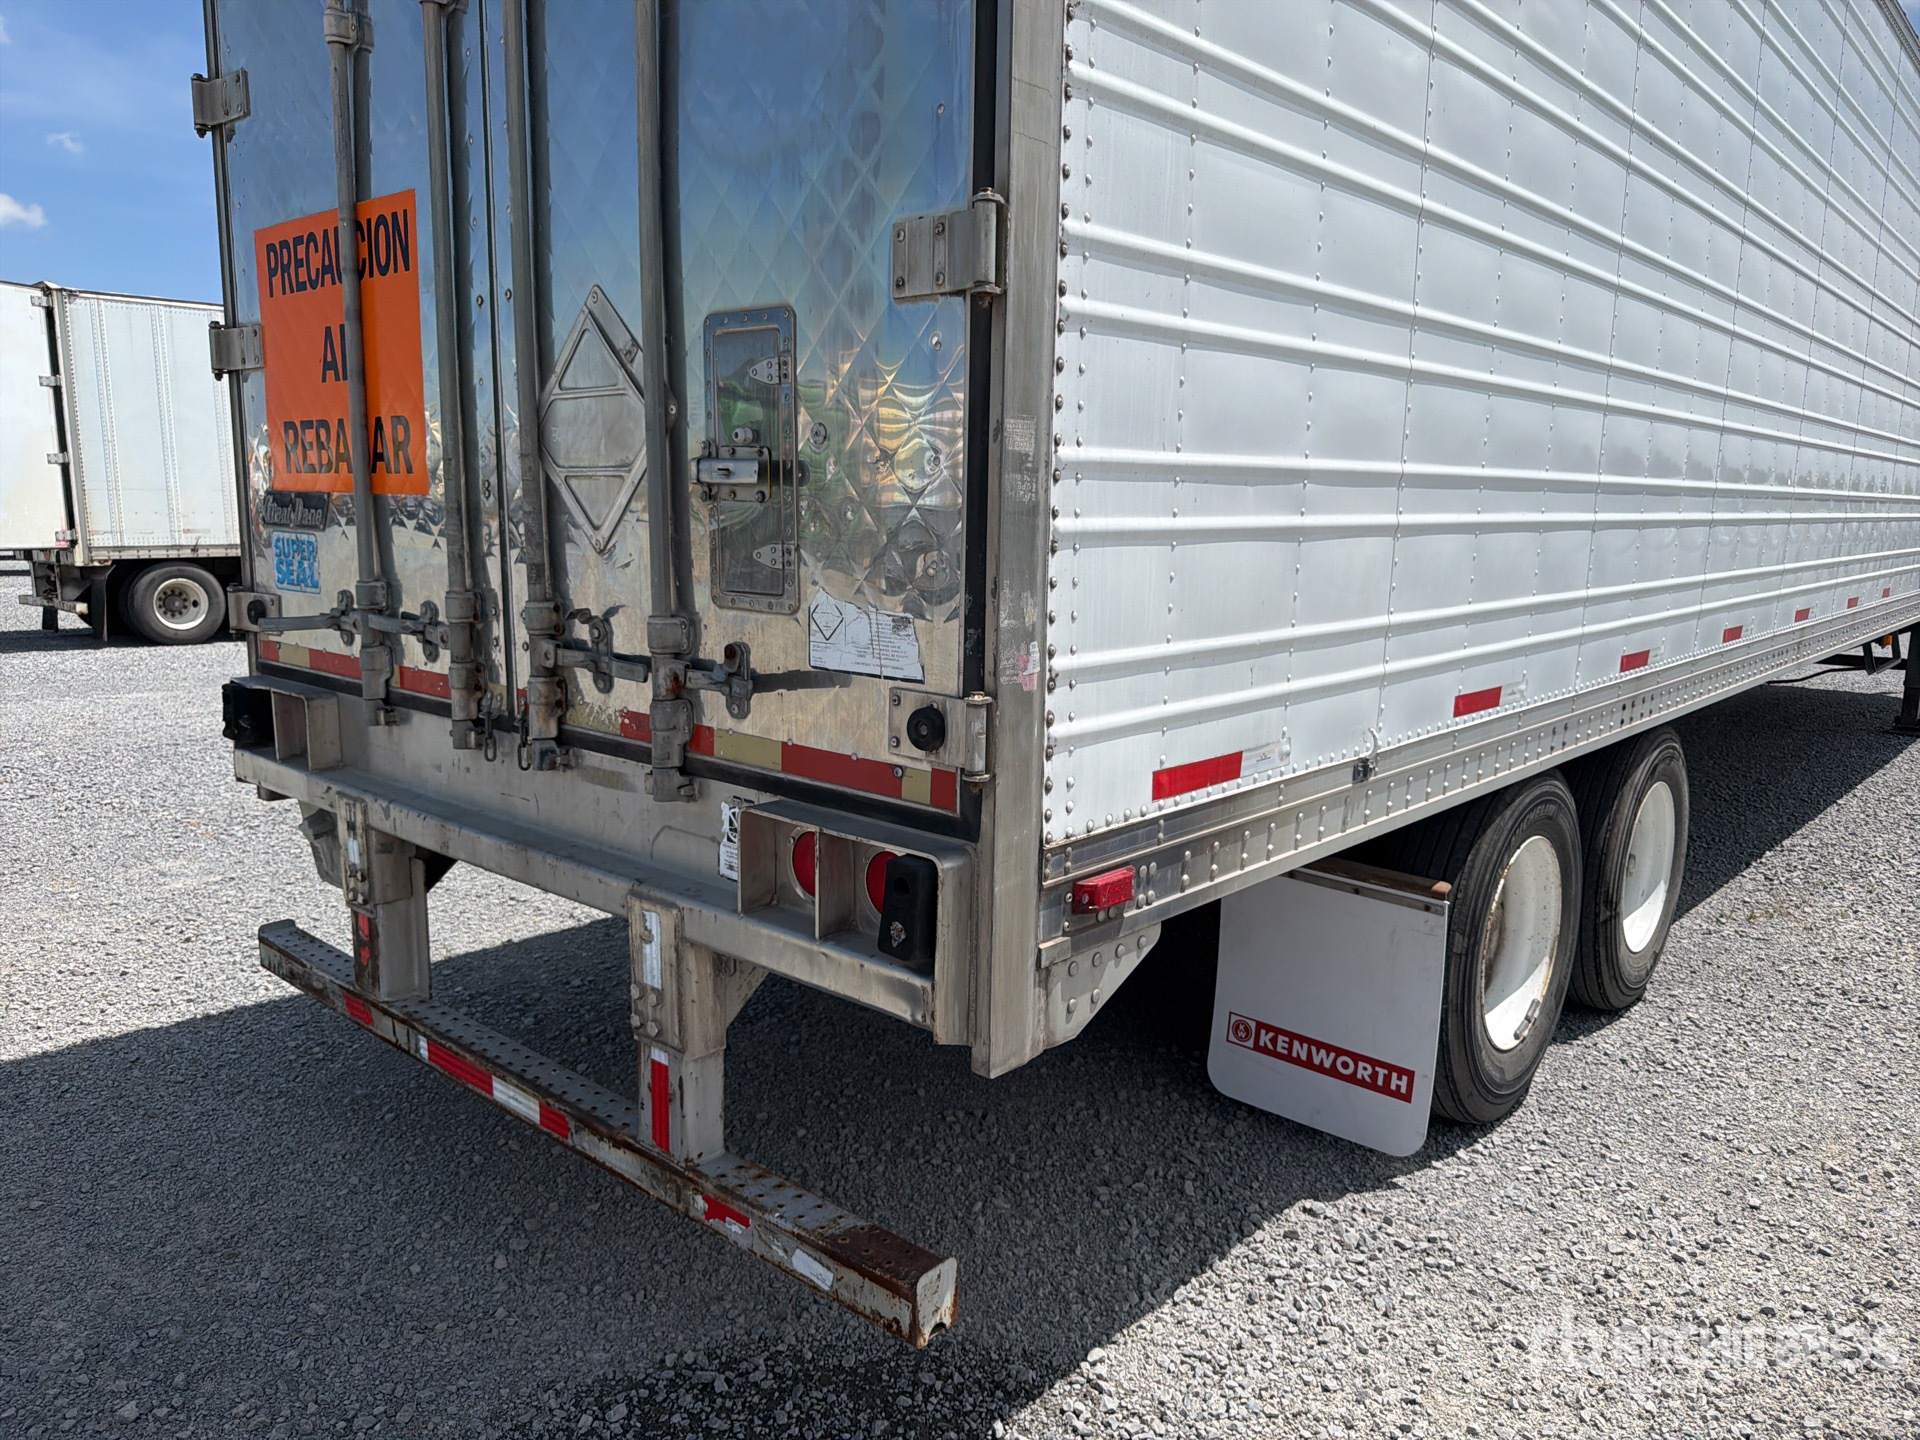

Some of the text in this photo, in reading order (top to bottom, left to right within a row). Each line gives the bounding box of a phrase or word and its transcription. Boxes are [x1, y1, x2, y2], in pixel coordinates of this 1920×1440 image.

[283, 415, 414, 474] REBAAR
[274, 536, 316, 561] SUPER
[275, 558, 319, 588] SEAL
[1259, 1028, 1408, 1094] KENWORTH
